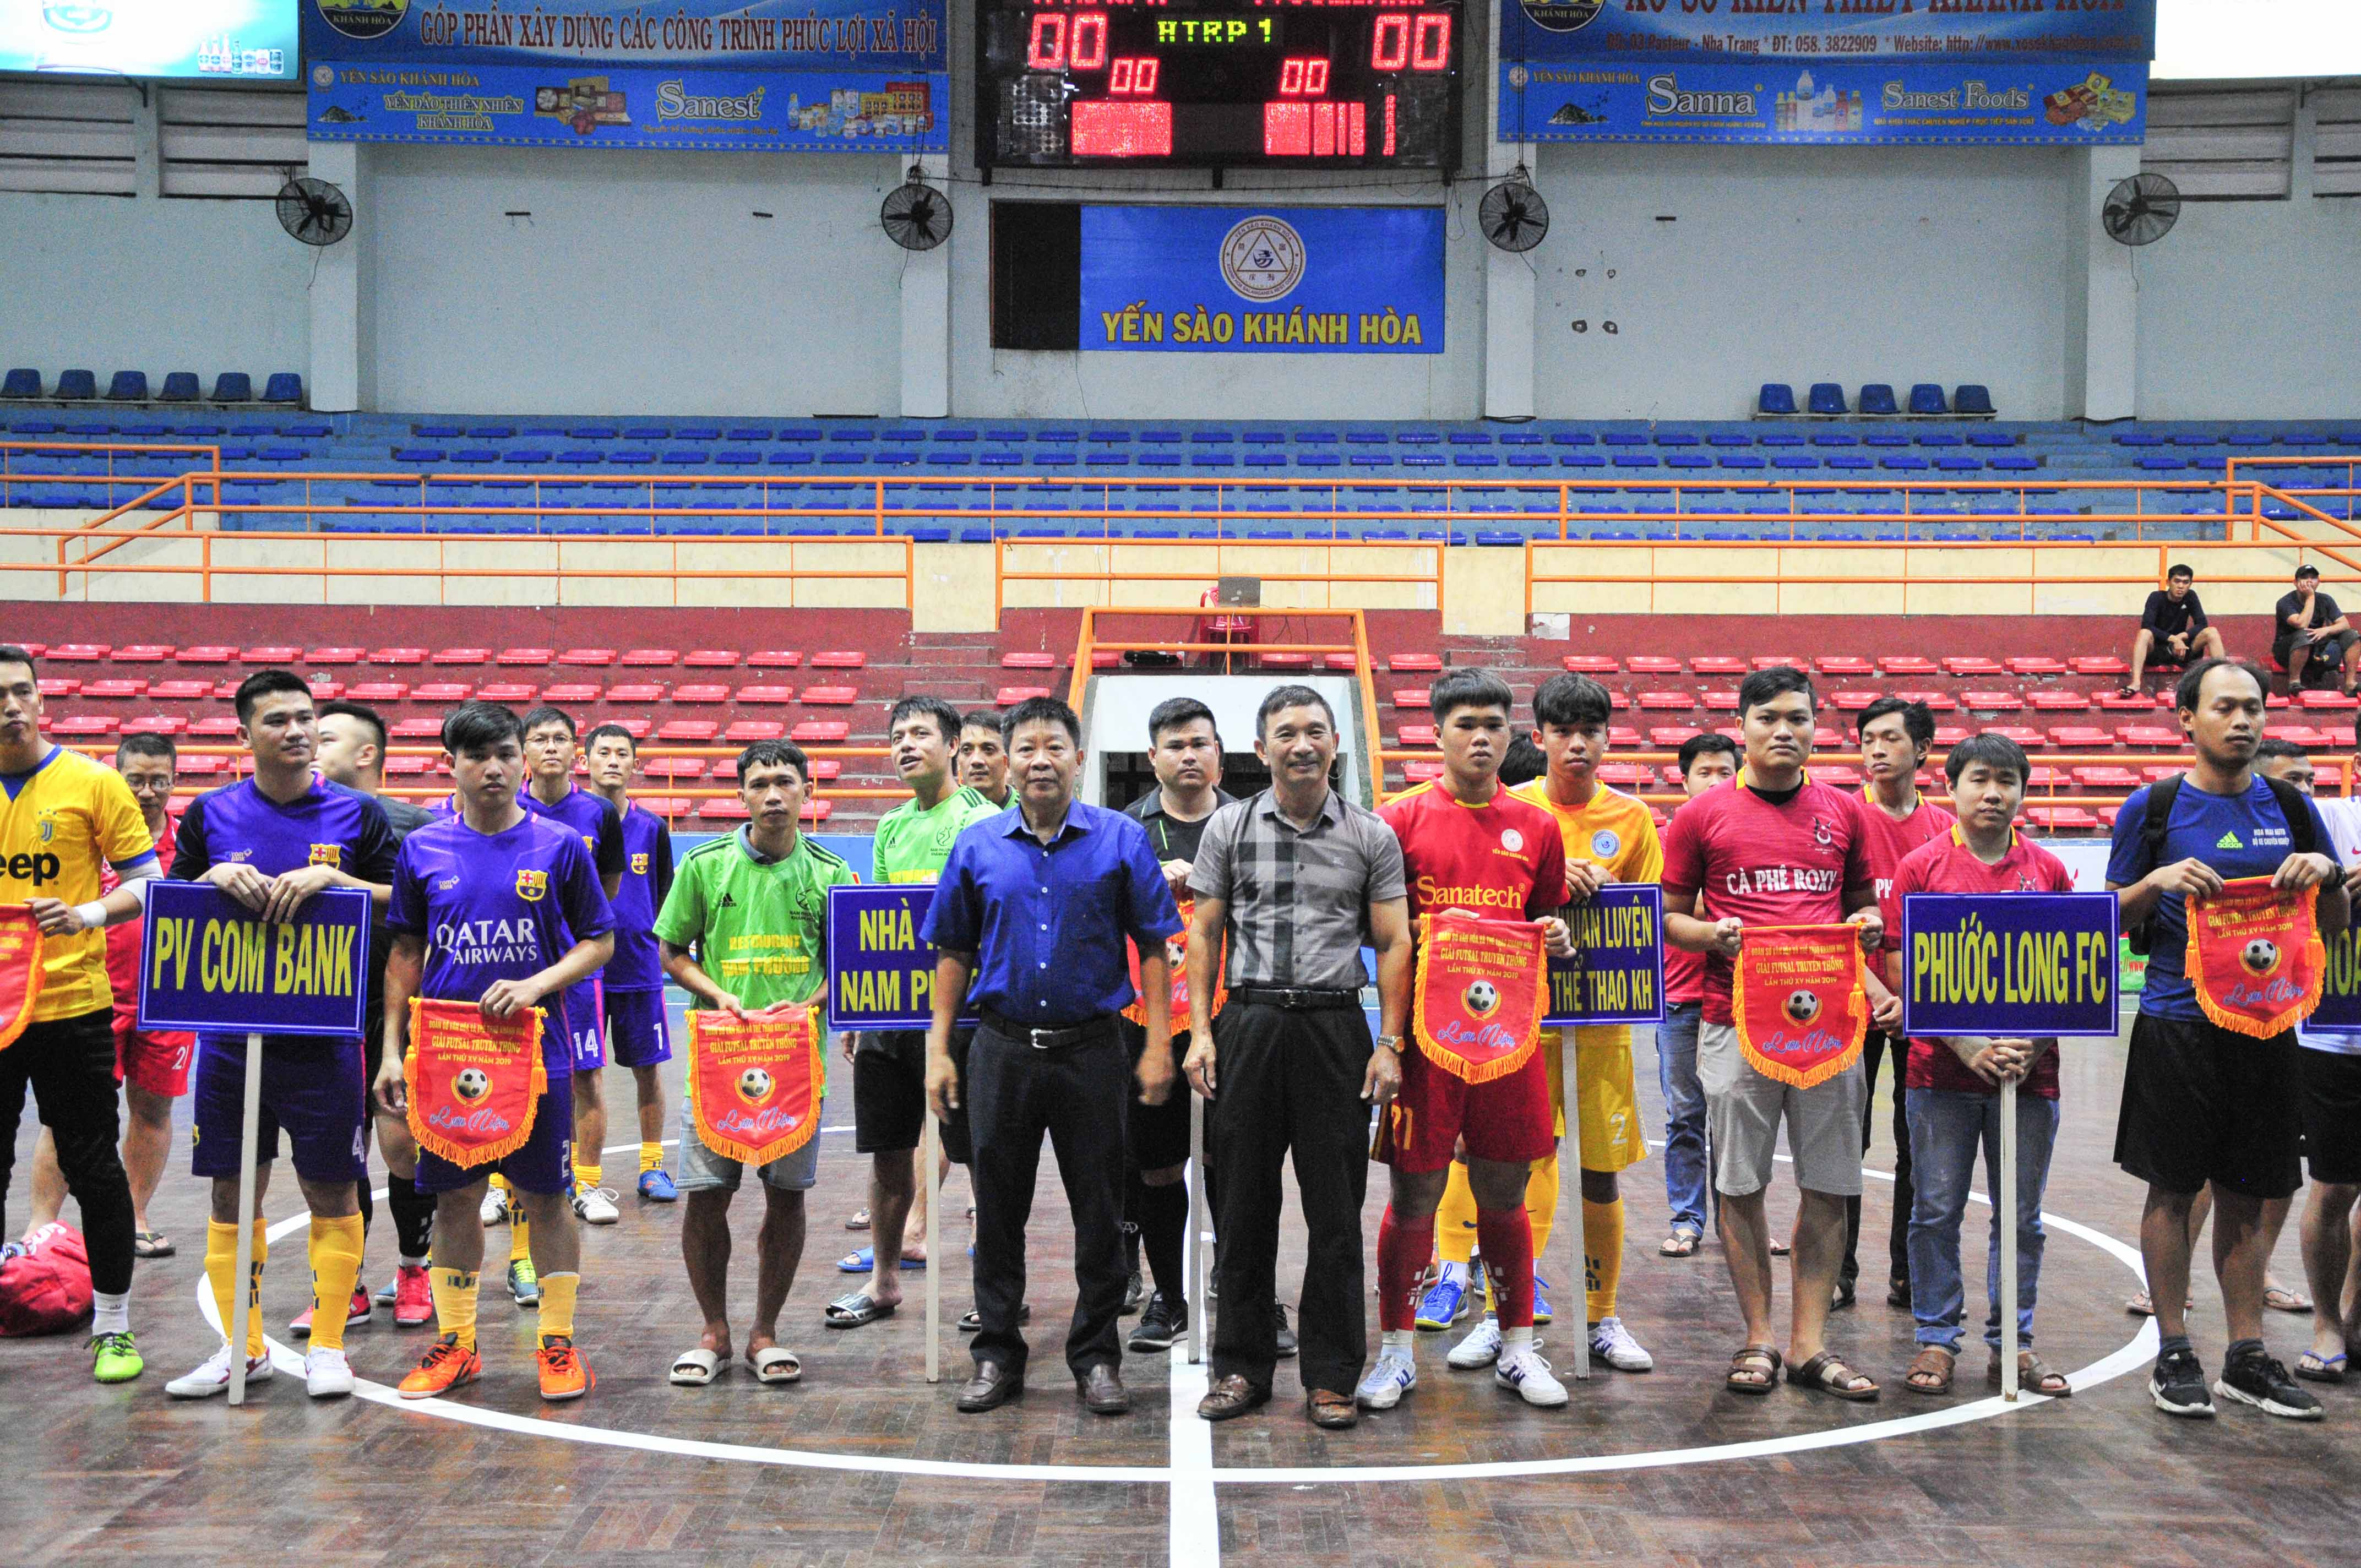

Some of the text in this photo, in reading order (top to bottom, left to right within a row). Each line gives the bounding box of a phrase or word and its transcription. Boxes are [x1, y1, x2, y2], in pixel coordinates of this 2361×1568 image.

[333, 14, 392, 25] KHÁNH HÒA
[420, 3, 458, 45] GÓP
[463, 1, 513, 46] PHẦN
[519, 6, 557, 47] XÂY
[562, 10, 614, 56] DỰNG
[619, 8, 657, 50] CÁC
[662, 8, 714, 51] CÔNG
[719, 9, 776, 51] TRÌNH
[781, 9, 831, 52] PHÚC
[835, 14, 867, 60] LỢI
[903, 9, 937, 60] HỘI
[1534, 8, 1588, 18] KHÁNH HÒA
[1702, 34, 1723, 51] Nha
[1727, 35, 1760, 55] Trang
[1772, 35, 1792, 52] ĐT:
[1796, 35, 1821, 52] 058.
[1825, 35, 1877, 52] 3822909
[1894, 35, 1943, 52] Website:
[400, 70, 447, 86] KHÁNH
[1109, 58, 1160, 94] 00
[1279, 58, 1330, 94] 00
[657, 79, 763, 121] Sanest
[1646, 72, 1756, 118] Sanna
[1883, 80, 2030, 112] Sanest Foods
[1101, 300, 1423, 345] YẾN SÀO KHÁNH HÒA
[1417, 876, 1521, 909] Sanatech
[1726, 864, 1837, 895] CÀ PHÊ ROXY
[436, 918, 536, 954] QATAR
[859, 897, 915, 951] NHÀ
[1604, 895, 1652, 955] LUYỆN
[153, 917, 356, 997] PV COM BANK
[453, 945, 537, 965] AIRWAYS
[1914, 912, 2107, 1004] PHƯỚC LONG FC
[840, 970, 900, 1012] NAM
[1553, 954, 1652, 1012] THỂ THAO KH
[573, 1028, 599, 1060] 14
[652, 1022, 663, 1051] 1
[352, 1125, 365, 1163] 4
[1609, 1113, 1629, 1145] 2
